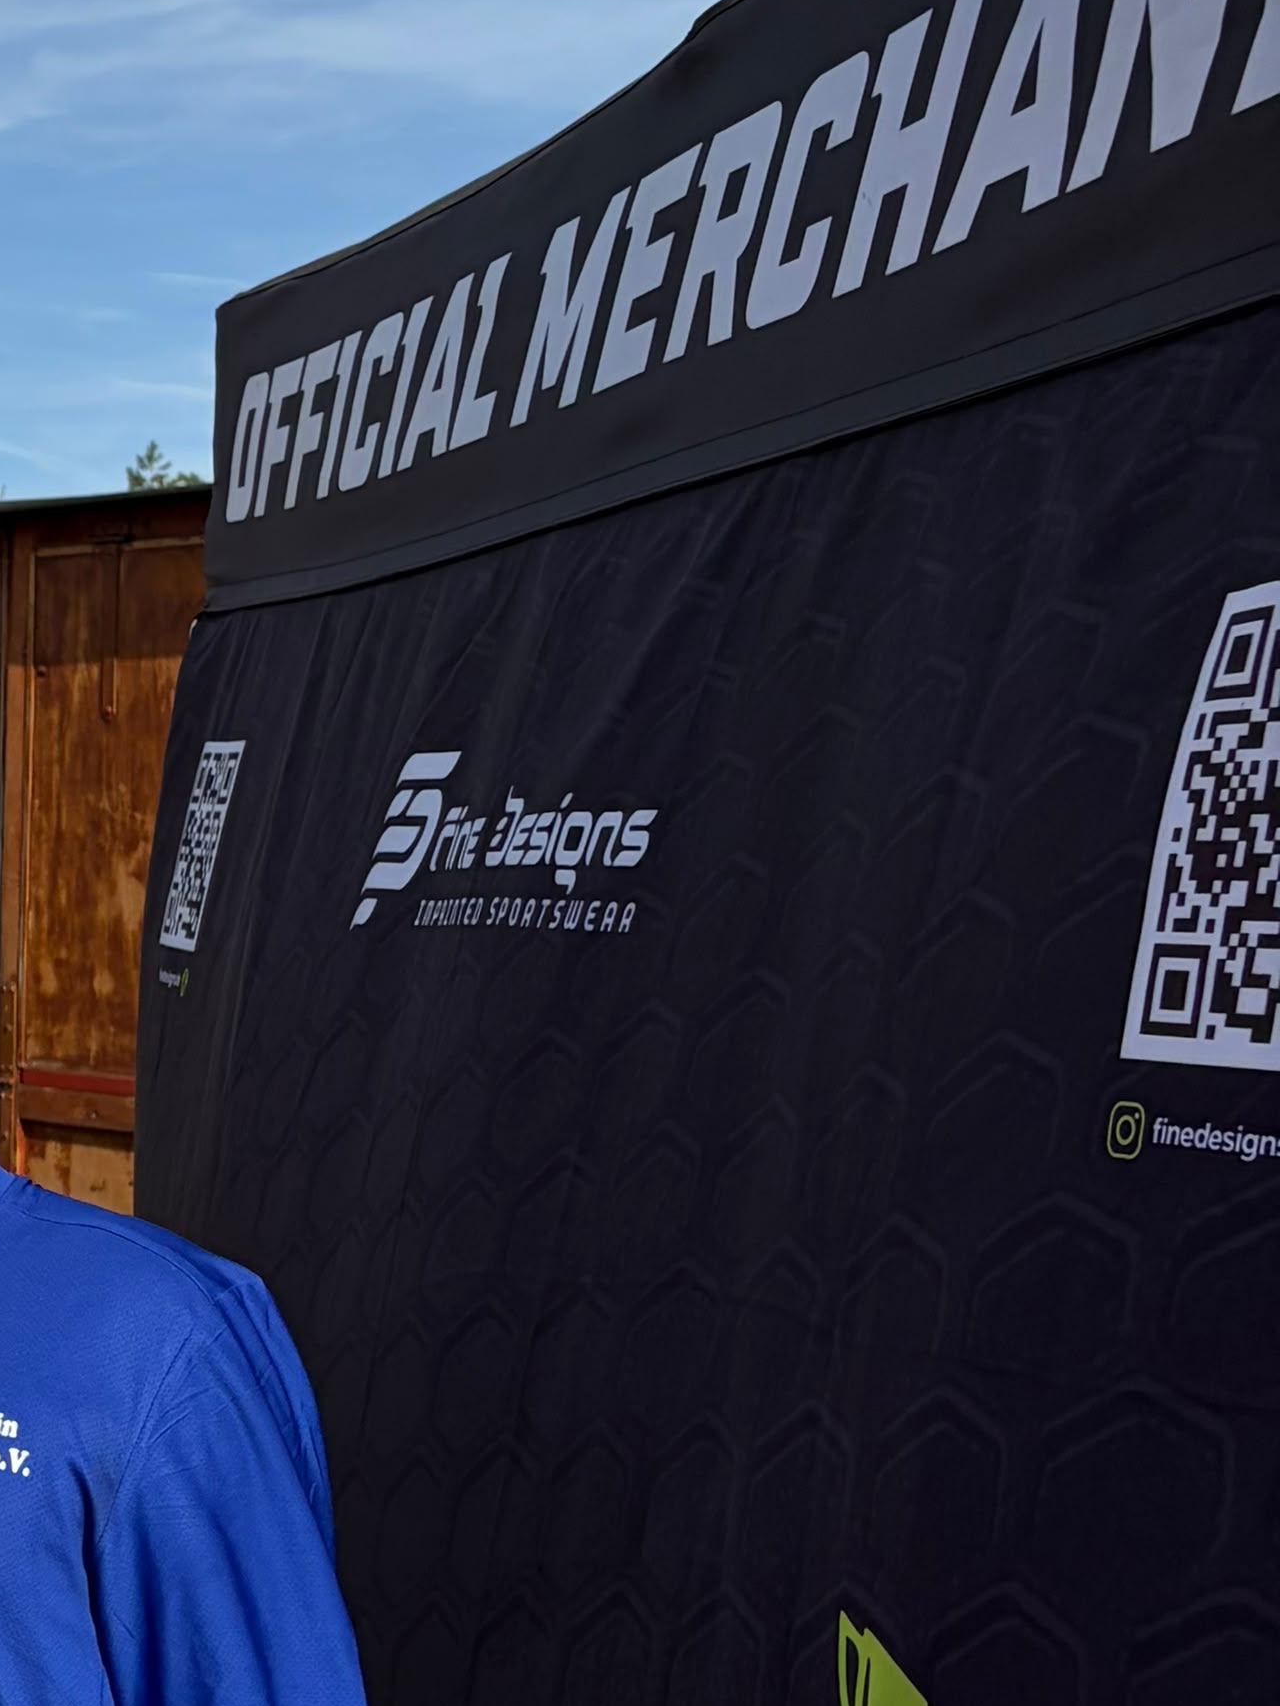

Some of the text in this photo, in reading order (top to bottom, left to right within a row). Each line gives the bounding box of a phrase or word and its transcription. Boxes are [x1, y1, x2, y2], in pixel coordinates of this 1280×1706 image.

[225, 252, 511, 524] OFFICIAL
[485, 785, 658, 895] Designs
[414, 897, 636, 934] IMPRINTED SPORTSWEAR
